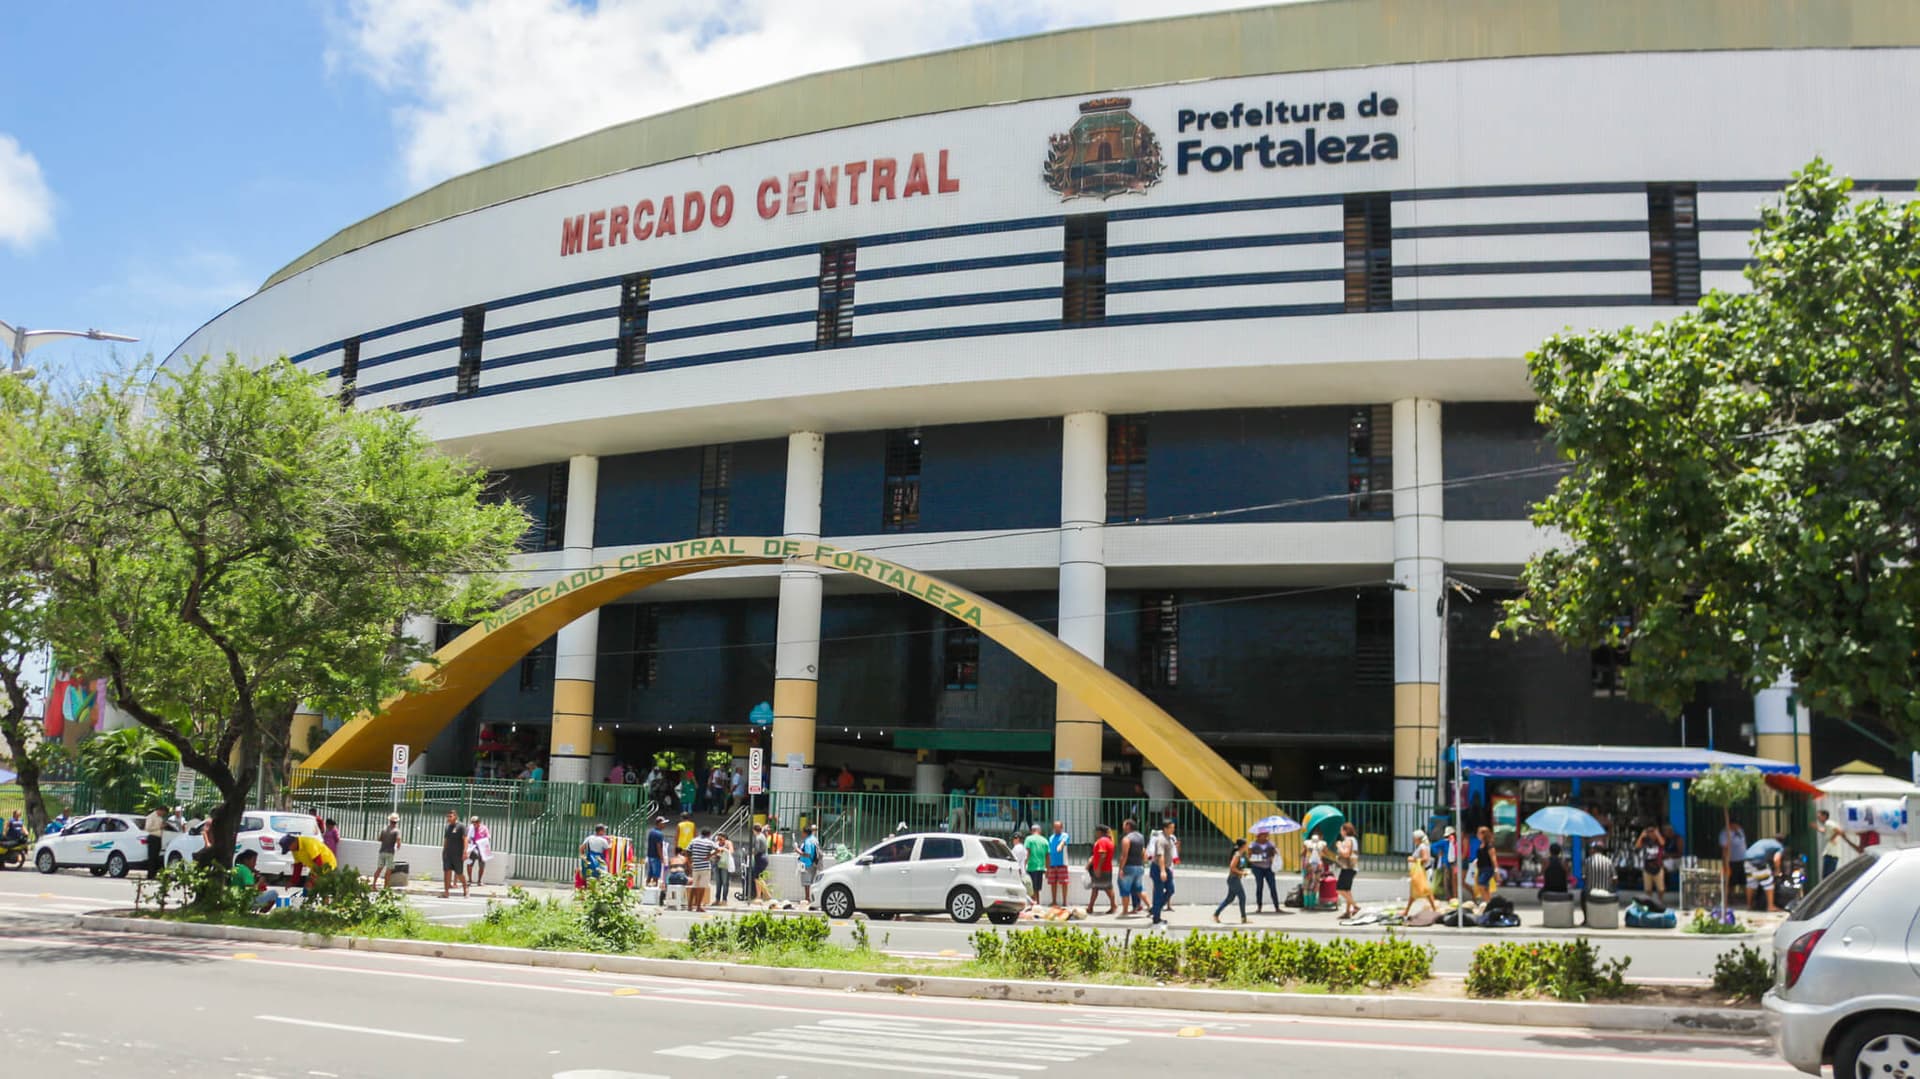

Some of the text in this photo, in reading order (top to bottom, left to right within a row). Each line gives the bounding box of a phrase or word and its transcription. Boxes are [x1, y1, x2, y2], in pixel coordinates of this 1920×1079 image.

[1178, 92, 1398, 133] Prefeitura de
[1177, 128, 1398, 175] Fortaleza
[560, 149, 960, 257] MERCADO CENTRAL
[483, 539, 982, 633] MERCADO CENTRAL DE FORTALEZA
